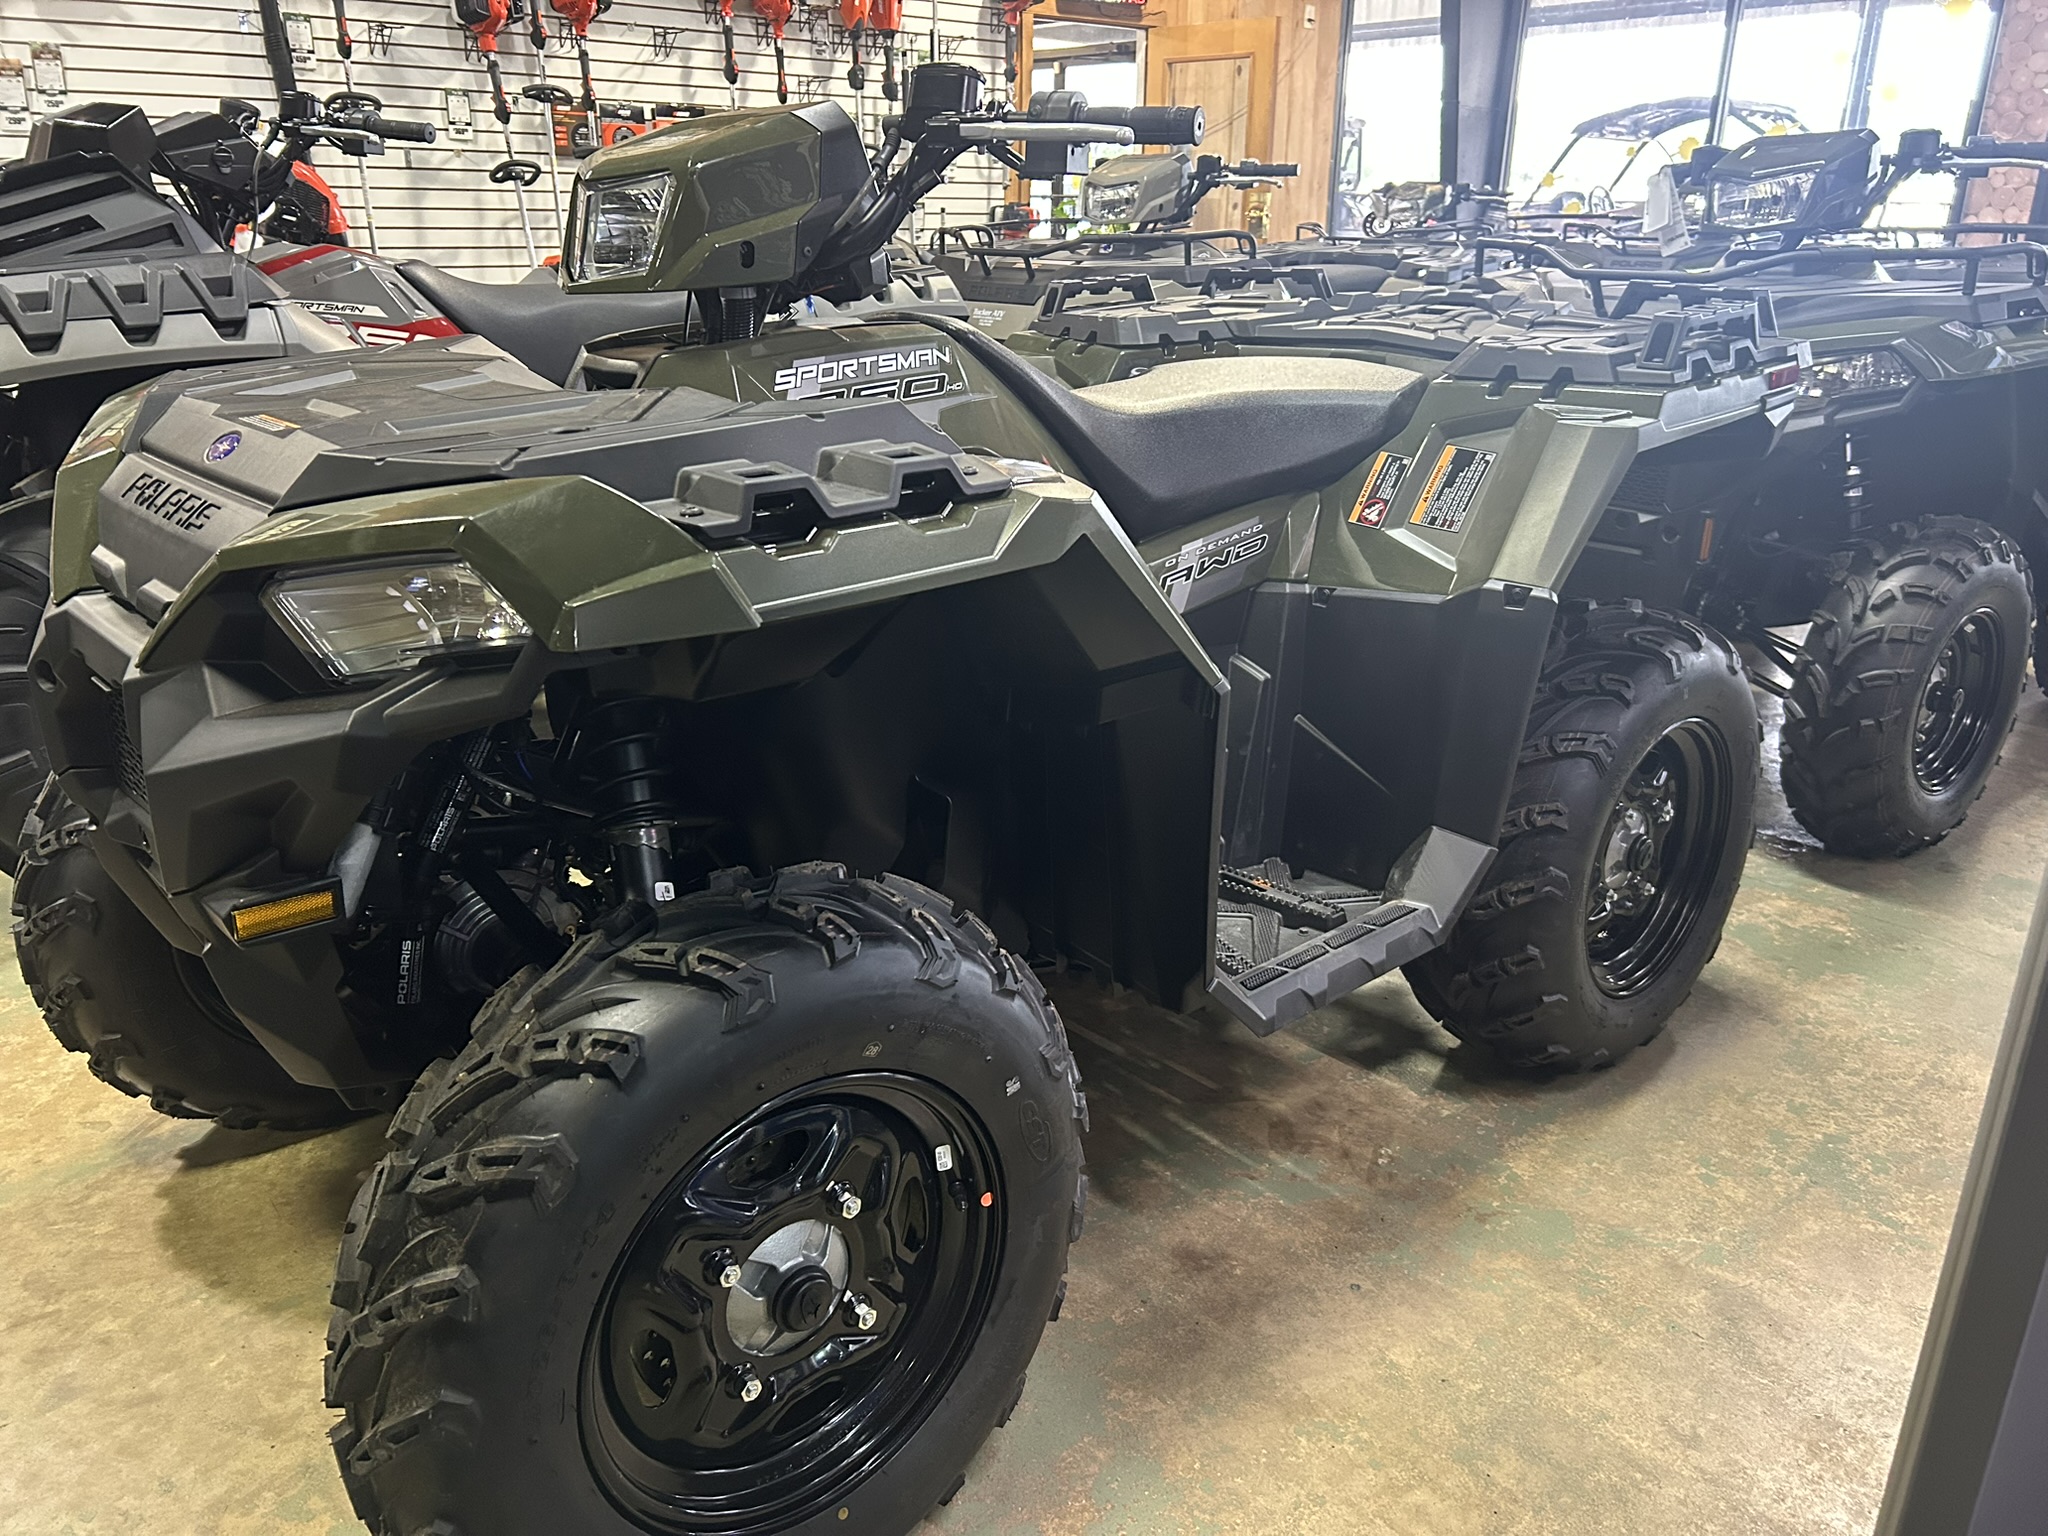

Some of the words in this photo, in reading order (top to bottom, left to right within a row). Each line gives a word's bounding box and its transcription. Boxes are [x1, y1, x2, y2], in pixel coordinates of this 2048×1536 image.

[773, 346, 952, 392] SPORTSMAN
[121, 472, 222, 533] POLARIS
[1361, 468, 1378, 500] WARNING
[1425, 464, 1444, 498] WARNING
[1159, 533, 1269, 592] AWD
[1165, 553, 1189, 568] ON
[1196, 524, 1263, 556] DEMAND
[430, 806, 455, 852] POLARIS
[397, 940, 411, 1005] POLARIS
[865, 1045, 879, 1056] 28
